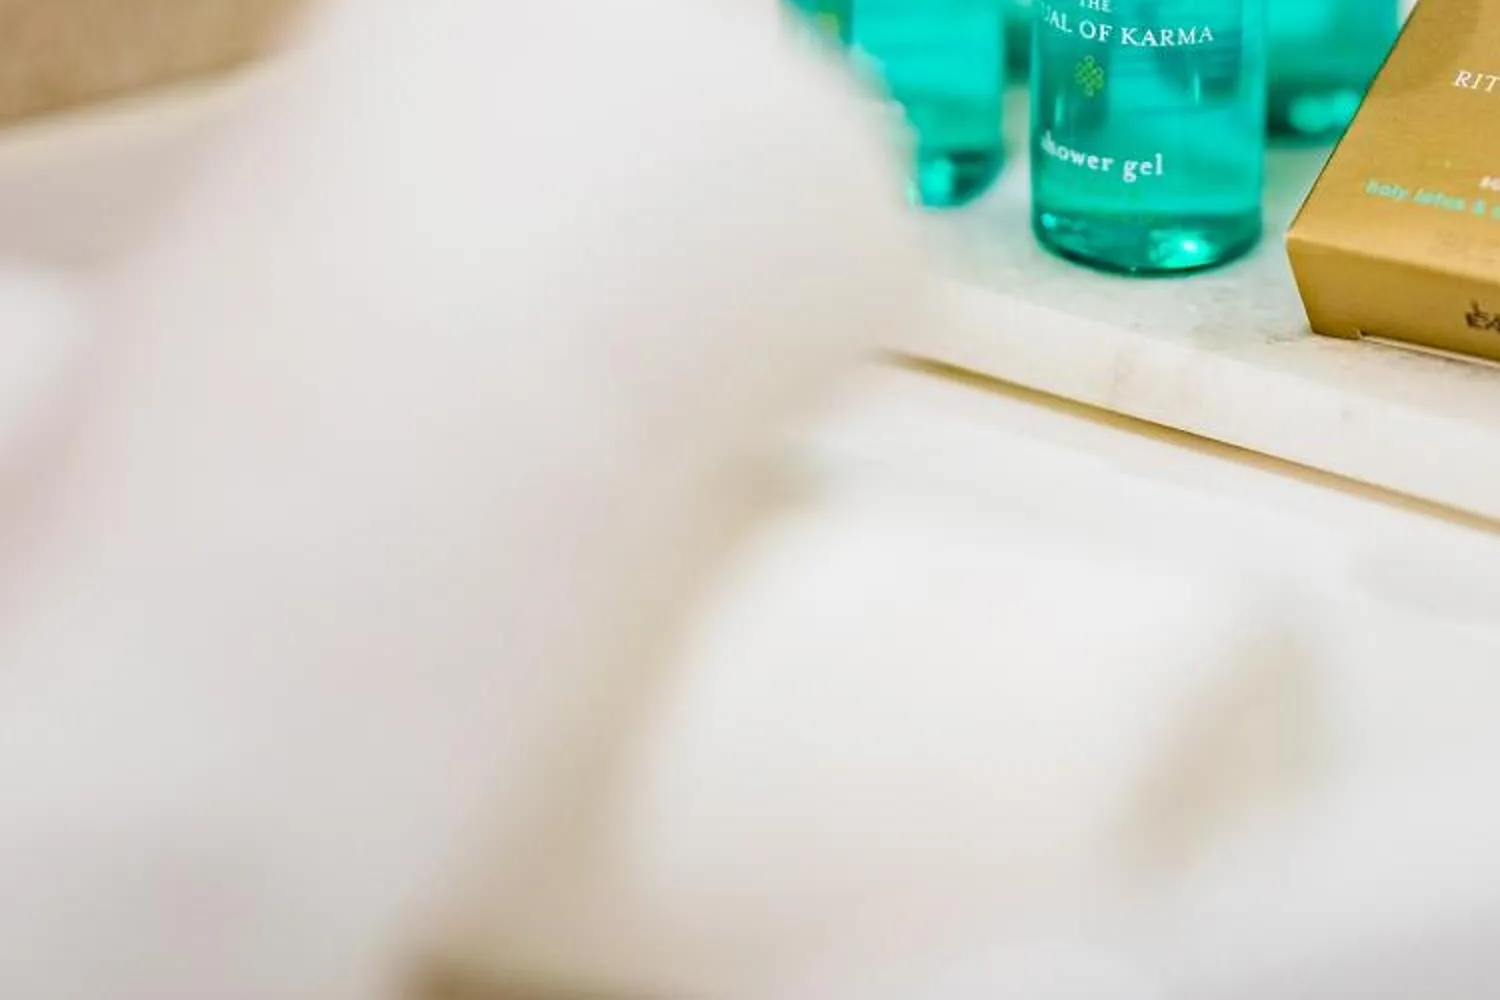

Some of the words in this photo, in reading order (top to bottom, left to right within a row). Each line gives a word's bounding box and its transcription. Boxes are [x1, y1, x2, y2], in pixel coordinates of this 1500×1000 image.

[1079, 19, 1112, 42] OF
[1121, 25, 1214, 47] KARMA
[1122, 152, 1163, 183] gel
